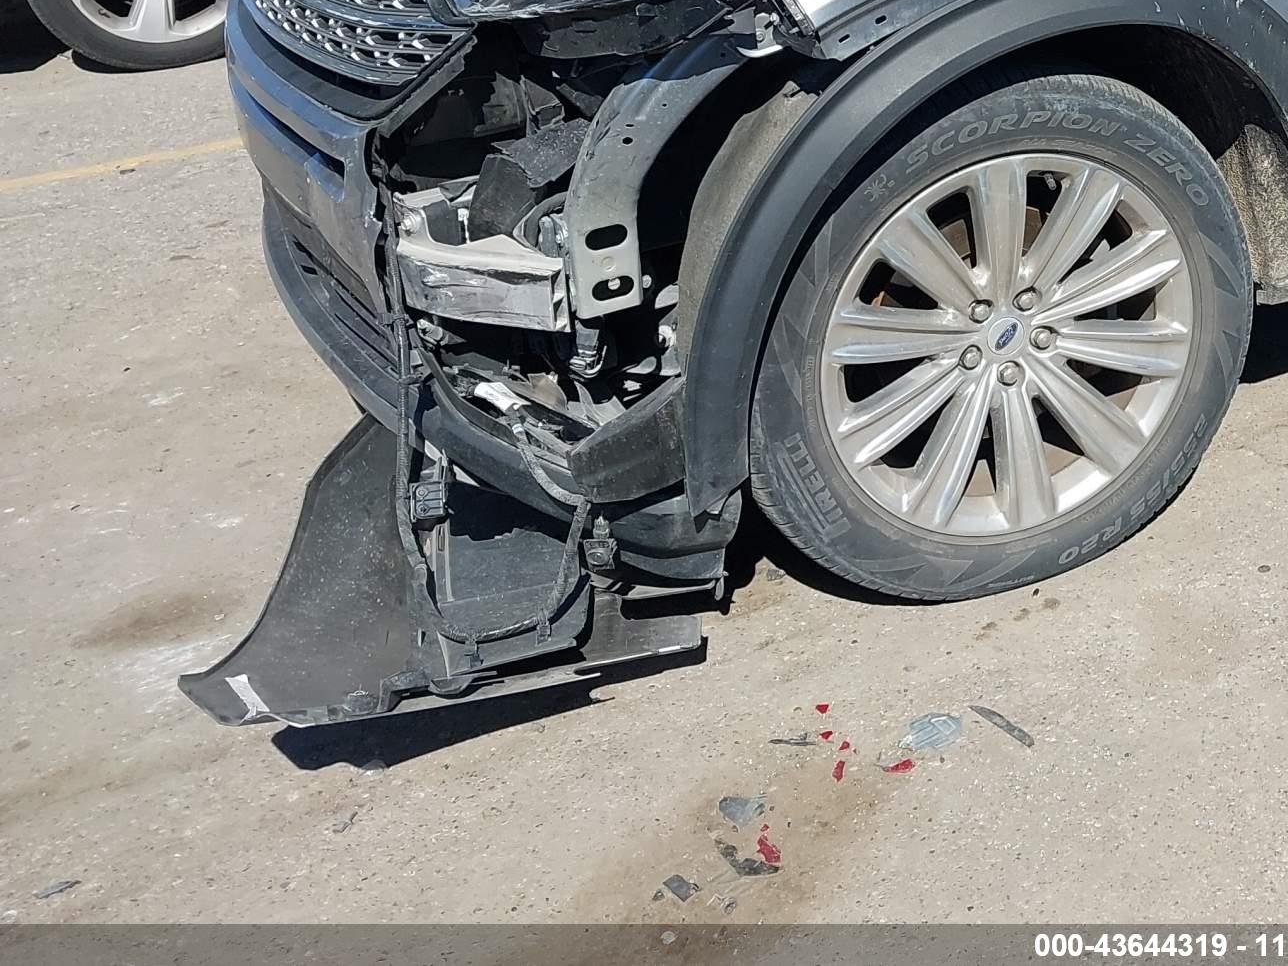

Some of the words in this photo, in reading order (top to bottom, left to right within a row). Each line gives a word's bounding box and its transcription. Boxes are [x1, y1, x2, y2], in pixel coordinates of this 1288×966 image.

[906, 110, 1121, 175] SCORPION
[1123, 133, 1209, 207] ZERO
[773, 432, 852, 540] PIRELLI
[1130, 413, 1208, 520] 255/55
[1058, 516, 1122, 565] R20
